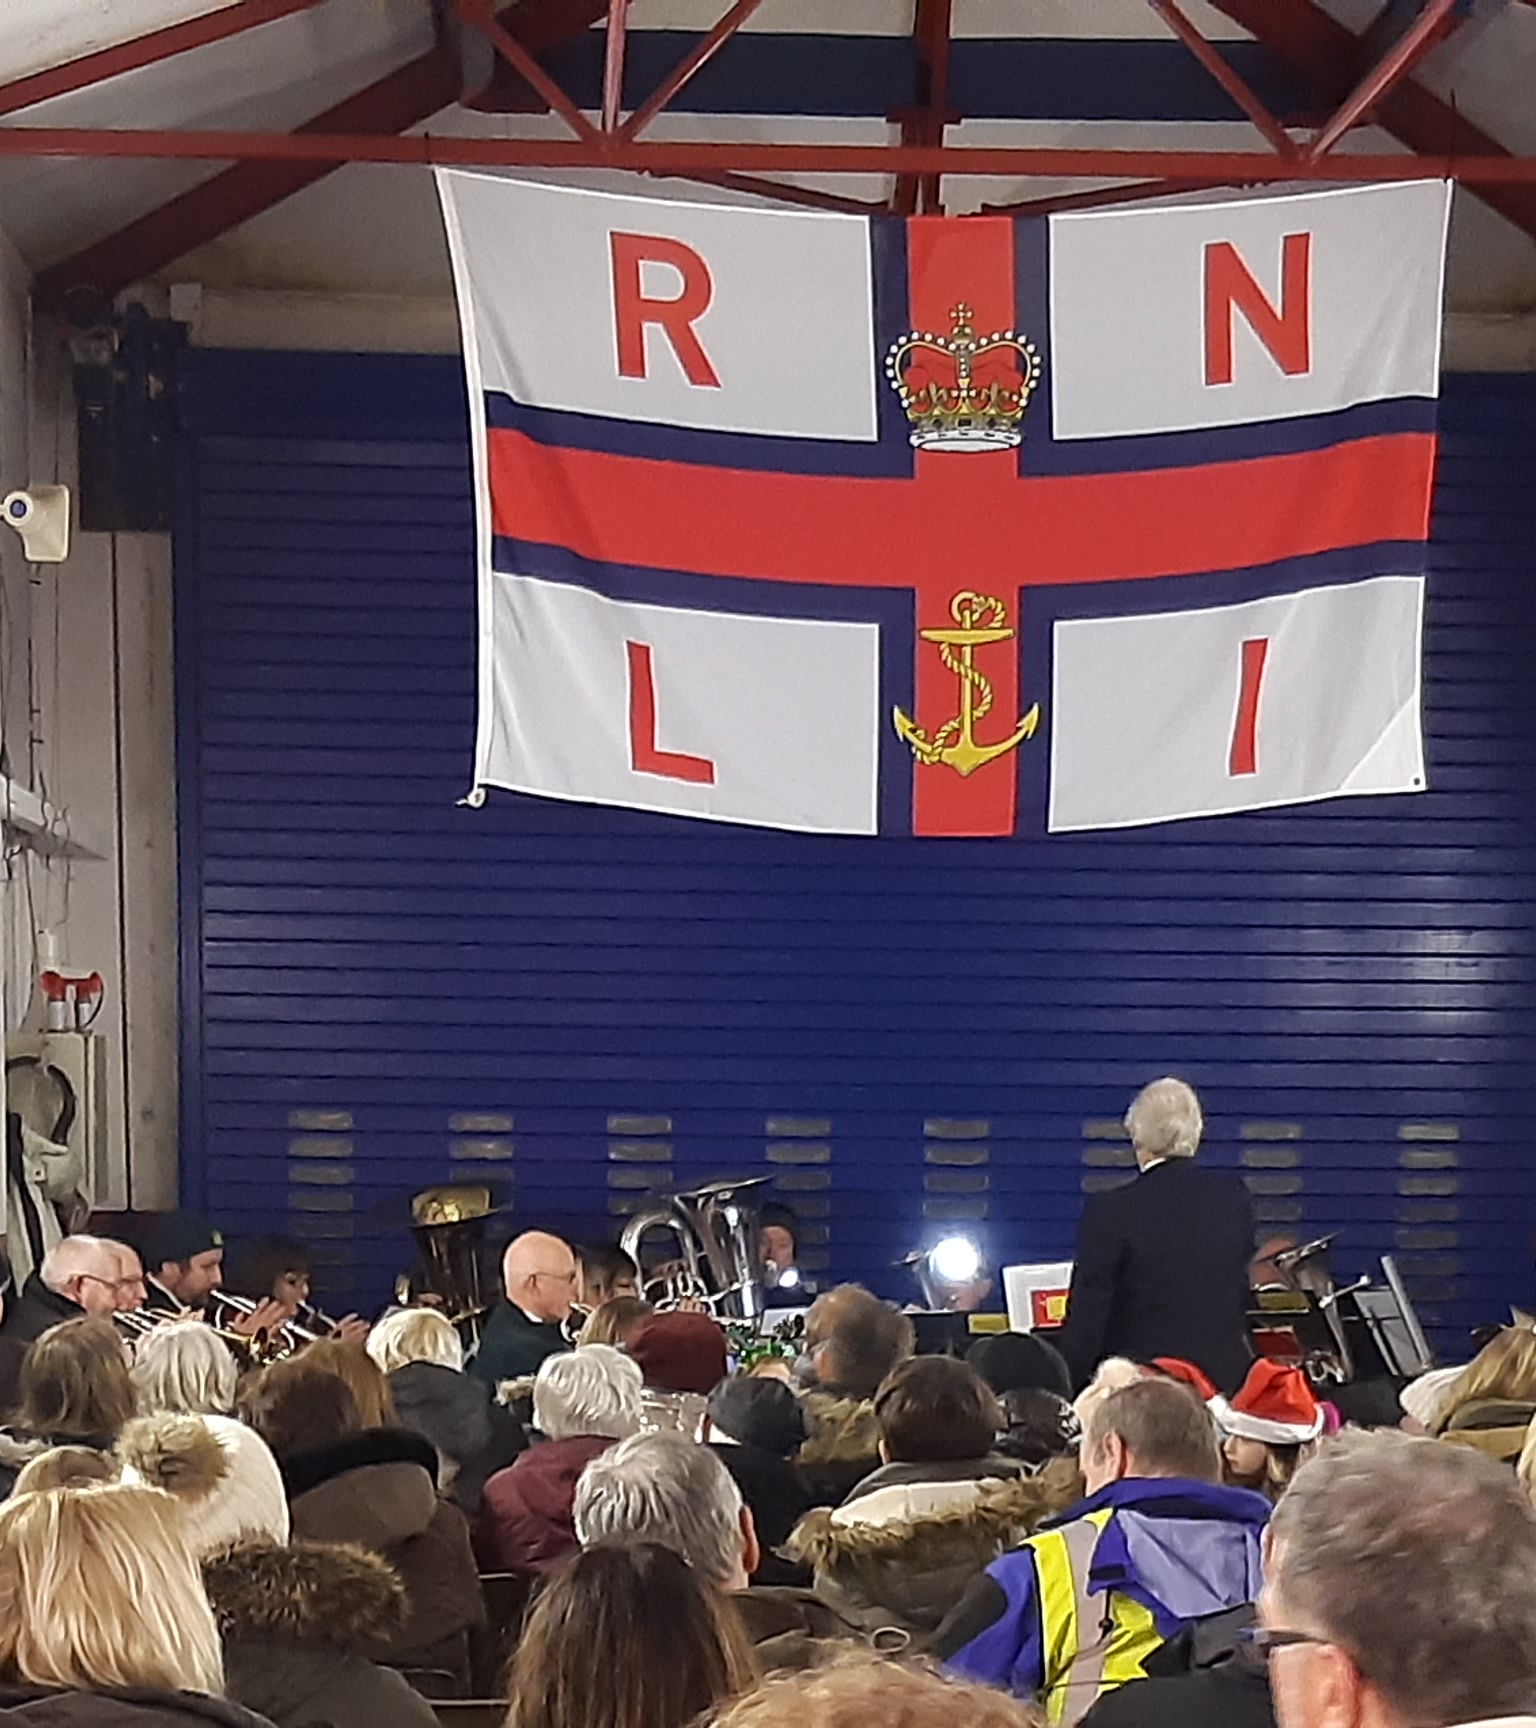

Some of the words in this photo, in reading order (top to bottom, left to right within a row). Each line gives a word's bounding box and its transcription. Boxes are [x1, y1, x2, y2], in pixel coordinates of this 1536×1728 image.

[609, 231, 721, 388] R
[1203, 231, 1311, 387] N
[626, 640, 715, 785] L
[1229, 637, 1269, 776] I
